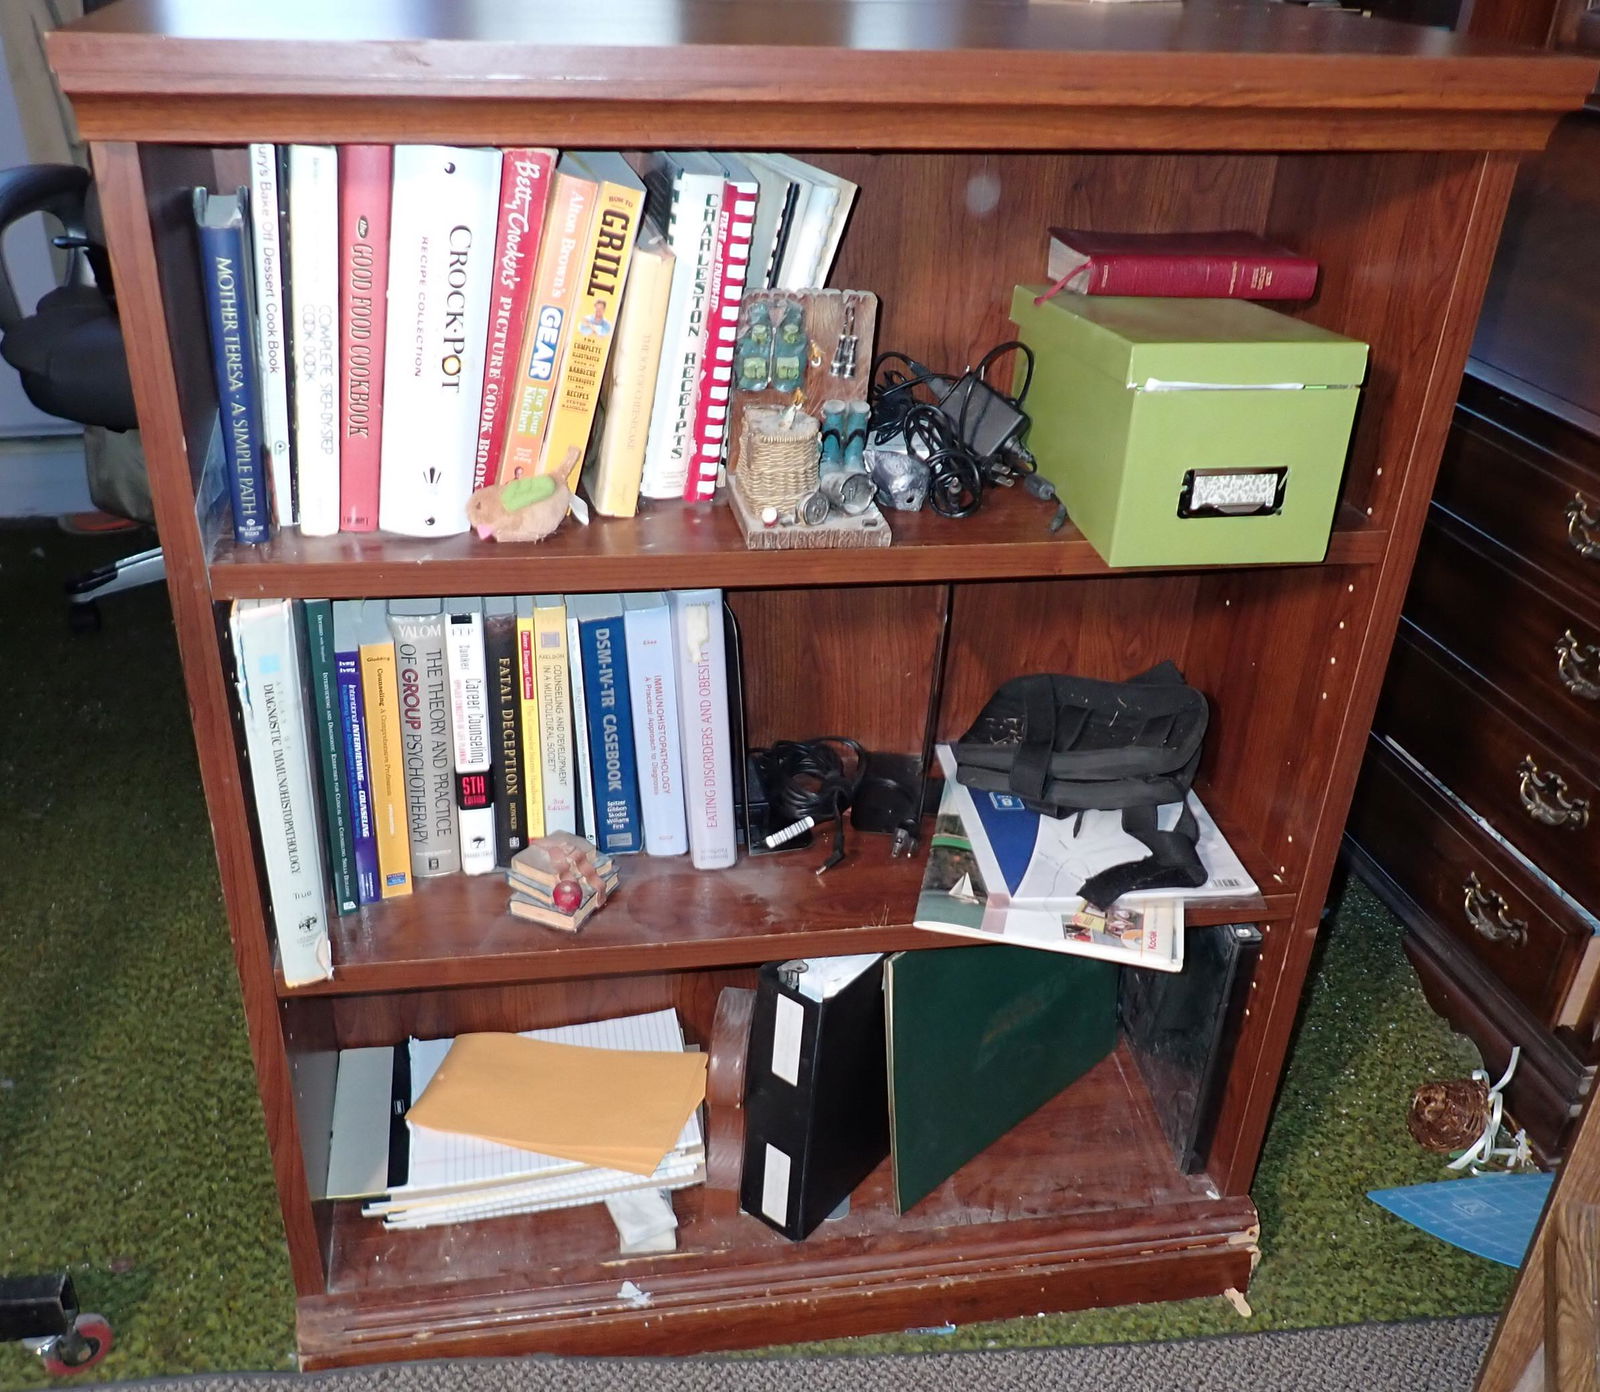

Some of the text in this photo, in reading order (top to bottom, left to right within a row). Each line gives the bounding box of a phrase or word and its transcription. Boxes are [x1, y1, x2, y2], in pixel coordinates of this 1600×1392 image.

[259, 181, 272, 216] Bake
[262, 221, 274, 242] Off
[552, 191, 585, 298] Alton Brown's
[586, 209, 630, 298] GRILL
[263, 247, 276, 298] Dessert
[352, 243, 374, 291] GOOD
[687, 193, 720, 337] CHARLESTON
[266, 303, 279, 337] Cook
[350, 295, 373, 340] FOOD
[414, 236, 429, 377] RECIPE COLLECTION
[473, 161, 540, 490] Betty Crocker's PICTURE COOK BOOK
[268, 340, 281, 374] Book
[527, 309, 564, 379] GEAR
[573, 342, 602, 354] COMPLETE
[215, 257, 257, 515] MOTHER TERESA A SIMPLE PATH
[347, 345, 372, 439] COOKBOOK
[566, 389, 589, 400] RECIPES
[569, 366, 597, 378] BARBECUE
[517, 385, 537, 433] Kitchen
[529, 387, 549, 435] For Your
[671, 351, 697, 461] RECEIPTS
[398, 624, 441, 637] YALOM
[374, 668, 387, 706] Counseling
[425, 648, 443, 678] THE
[543, 665, 551, 673] IN
[347, 683, 360, 723] Intentional
[426, 680, 447, 736] THEORY
[463, 677, 489, 764] Career Counseling
[498, 657, 517, 795] FATAL DECEPTION
[542, 682, 555, 739] MULTICULTURAL
[551, 664, 569, 786] COUNSELING AND DEVELOPMENT
[595, 628, 624, 792] DSM-IV-TR CASEBOOK
[702, 698, 714, 724] AND
[350, 723, 365, 781] INTERVIEWING
[399, 642, 430, 845] OF GROUP PSYCHOTHERAPY
[430, 739, 448, 768] AND
[546, 742, 556, 773] SOCIETY
[653, 675, 670, 794] IMMUNOHISTOPATHOLOGY
[703, 728, 716, 786] DISORDERS
[262, 682, 302, 874] DIAGNOSTIC IMMUNOHISTOPATHOLOGY
[356, 789, 371, 838] COUNSELING
[431, 772, 454, 836] PRACTICE
[606, 817, 630, 825] Williams
[705, 788, 719, 828] EATING
